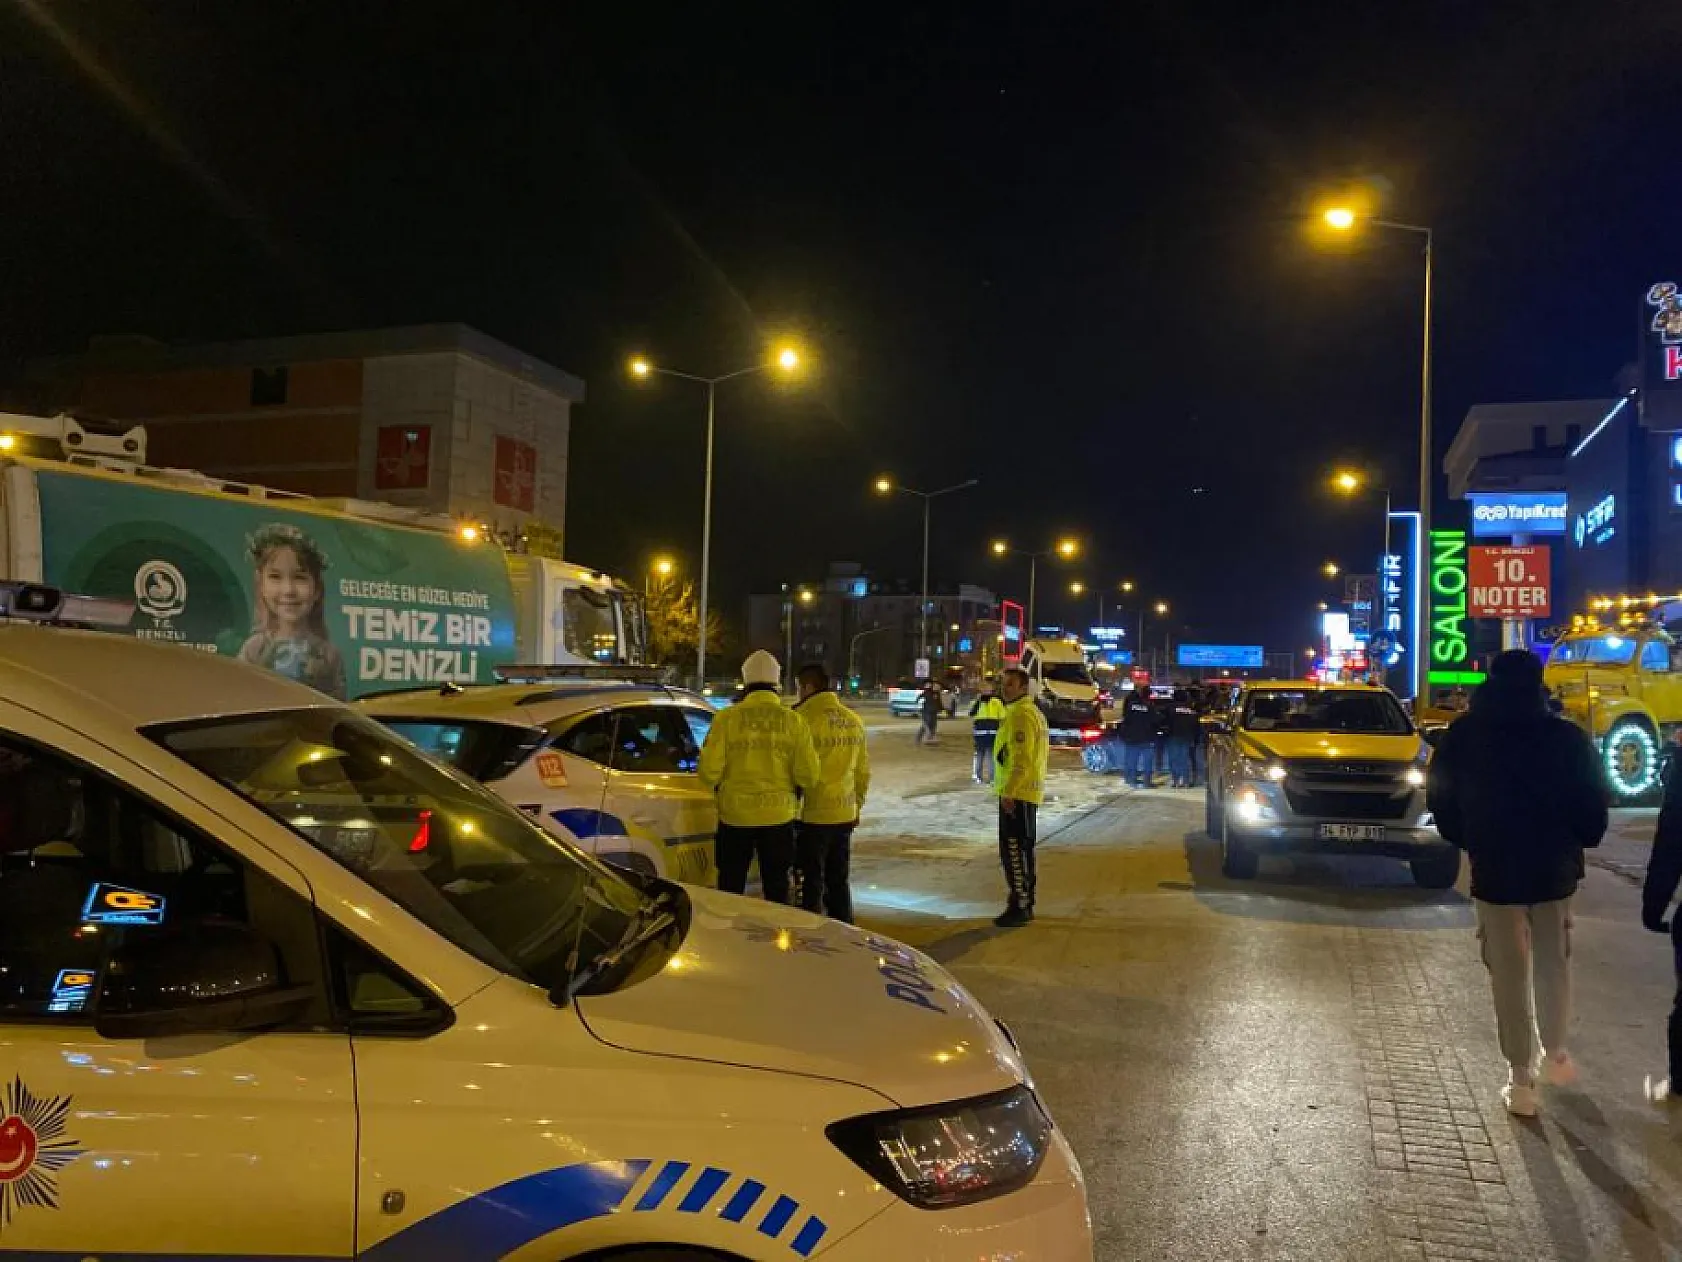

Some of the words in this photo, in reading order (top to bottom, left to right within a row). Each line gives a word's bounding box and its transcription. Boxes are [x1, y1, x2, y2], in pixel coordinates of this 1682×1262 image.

[1493, 558, 1536, 583] 10.
[401, 585, 416, 602] EN
[417, 585, 451, 605] GÜZEL
[1473, 586, 1547, 606] NOTER
